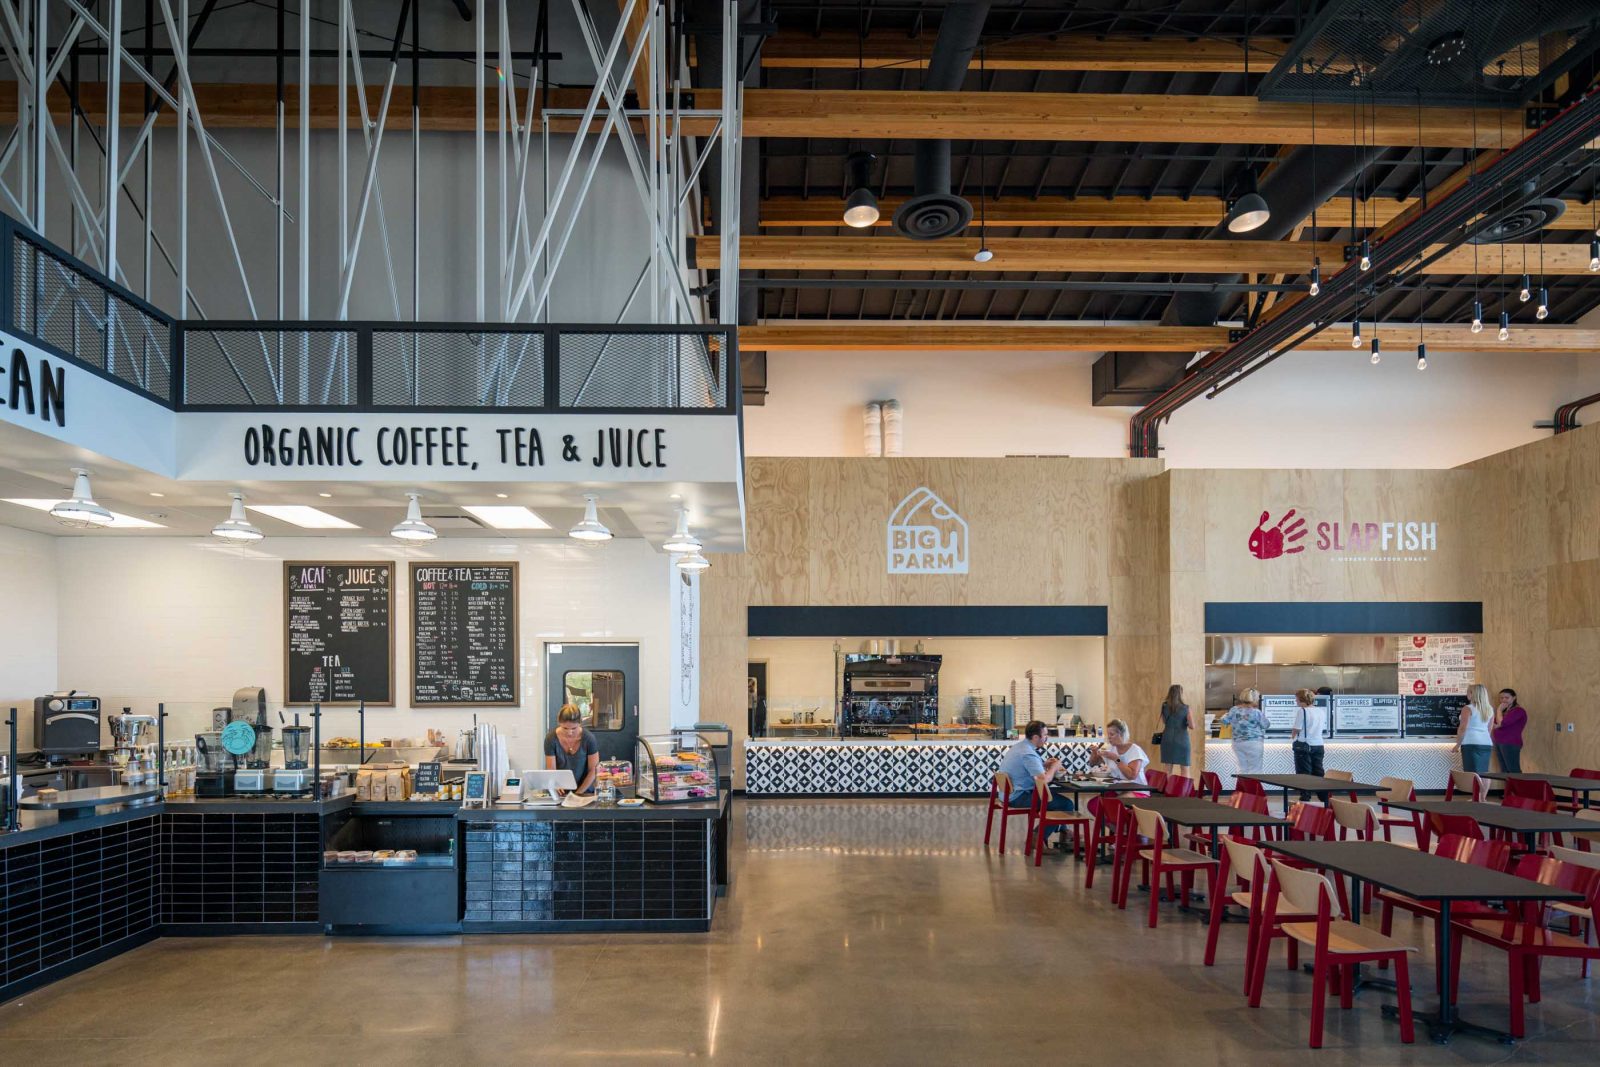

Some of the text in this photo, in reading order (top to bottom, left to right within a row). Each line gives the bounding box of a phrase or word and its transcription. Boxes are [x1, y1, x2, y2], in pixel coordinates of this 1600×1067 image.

[244, 424, 667, 470] ORGANIC COFFEE, TEA & JUICE
[892, 530, 936, 549] BIG
[1316, 522, 1437, 551] SLAPFISH
[892, 553, 954, 568] PARM
[345, 568, 376, 585] JUICE
[417, 568, 448, 581] COFFEE
[448, 570, 453, 581] &
[454, 568, 472, 581] TEA
[322, 654, 340, 667] TEA
